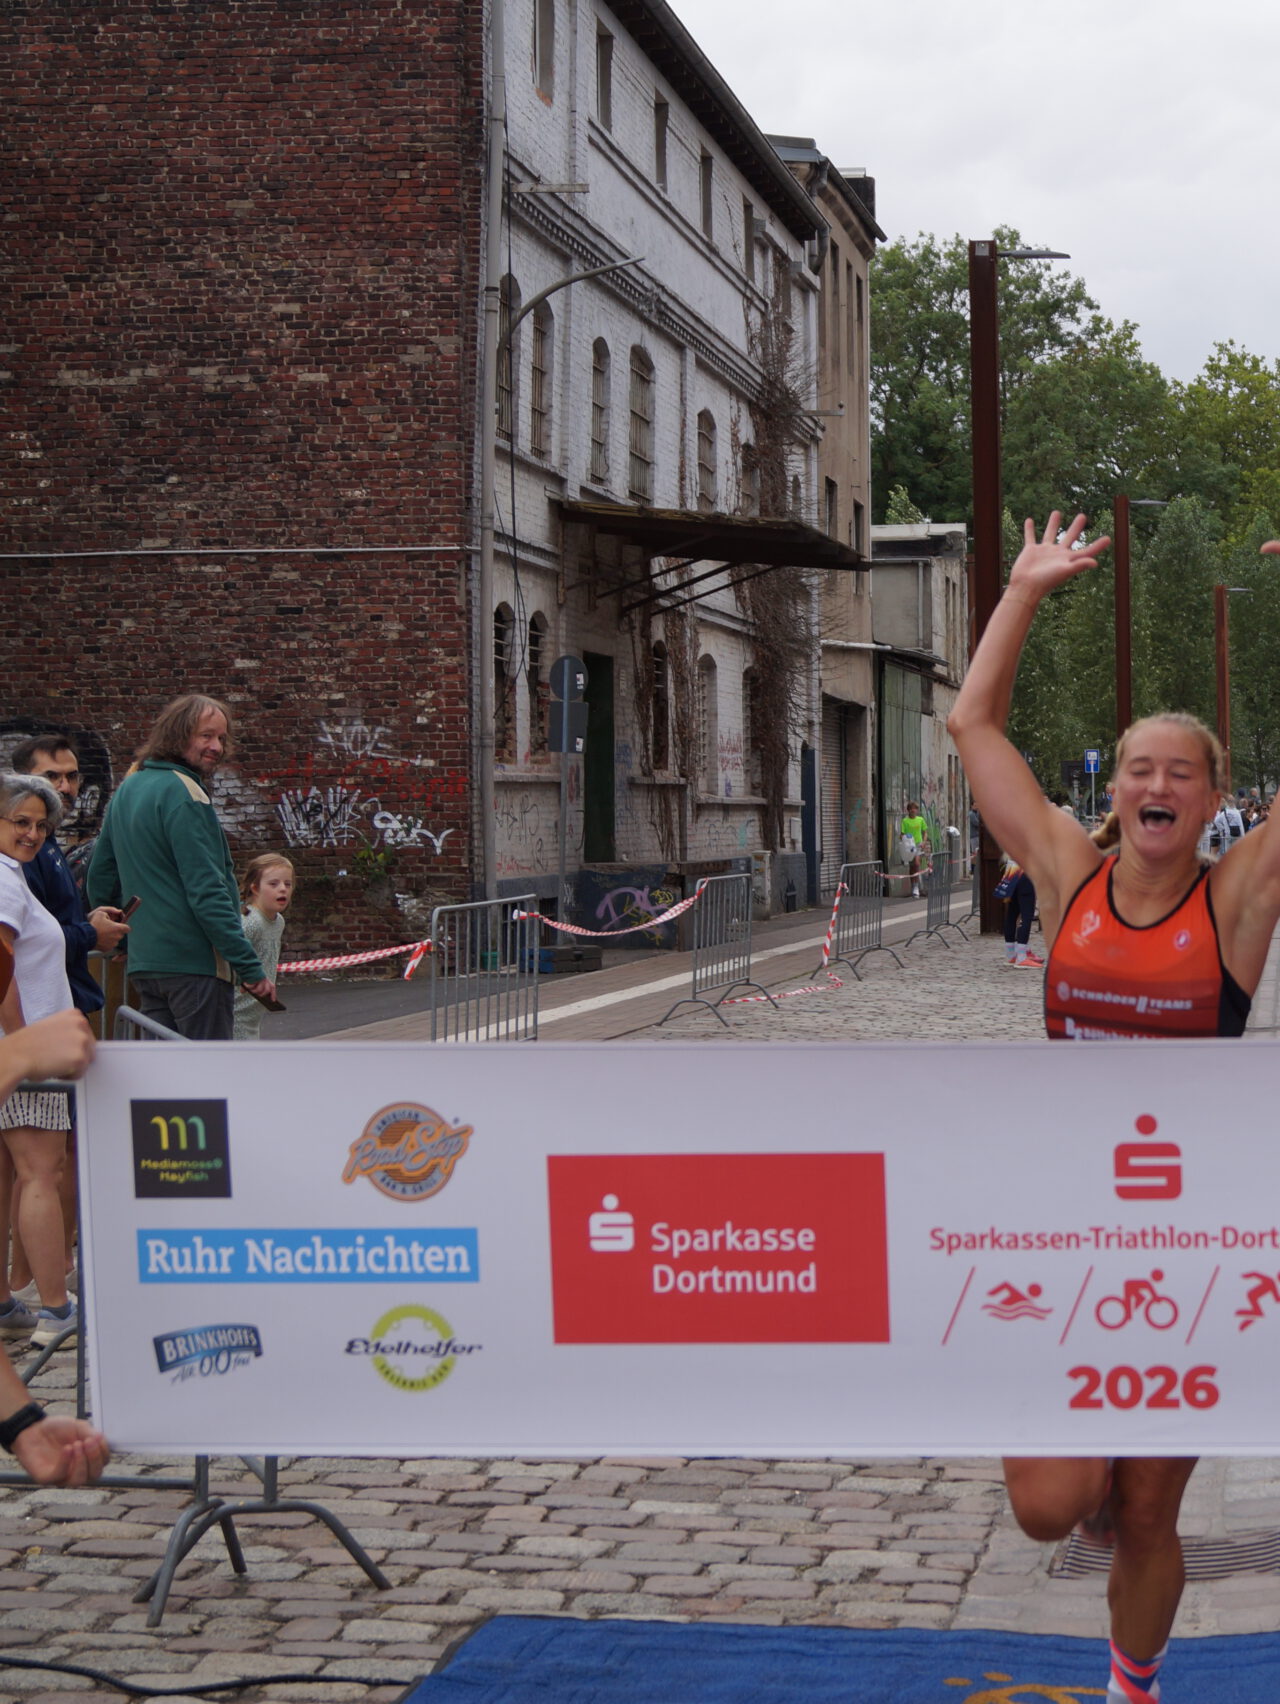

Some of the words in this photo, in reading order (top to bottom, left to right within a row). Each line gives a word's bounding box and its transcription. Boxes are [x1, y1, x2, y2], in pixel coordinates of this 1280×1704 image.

[146, 1236, 234, 1274] Ruhr
[244, 1236, 470, 1274] Nachrichten
[652, 1221, 815, 1258] Sparkasse
[653, 1263, 816, 1293] Dortmund
[1066, 1365, 1220, 1410] 2026
